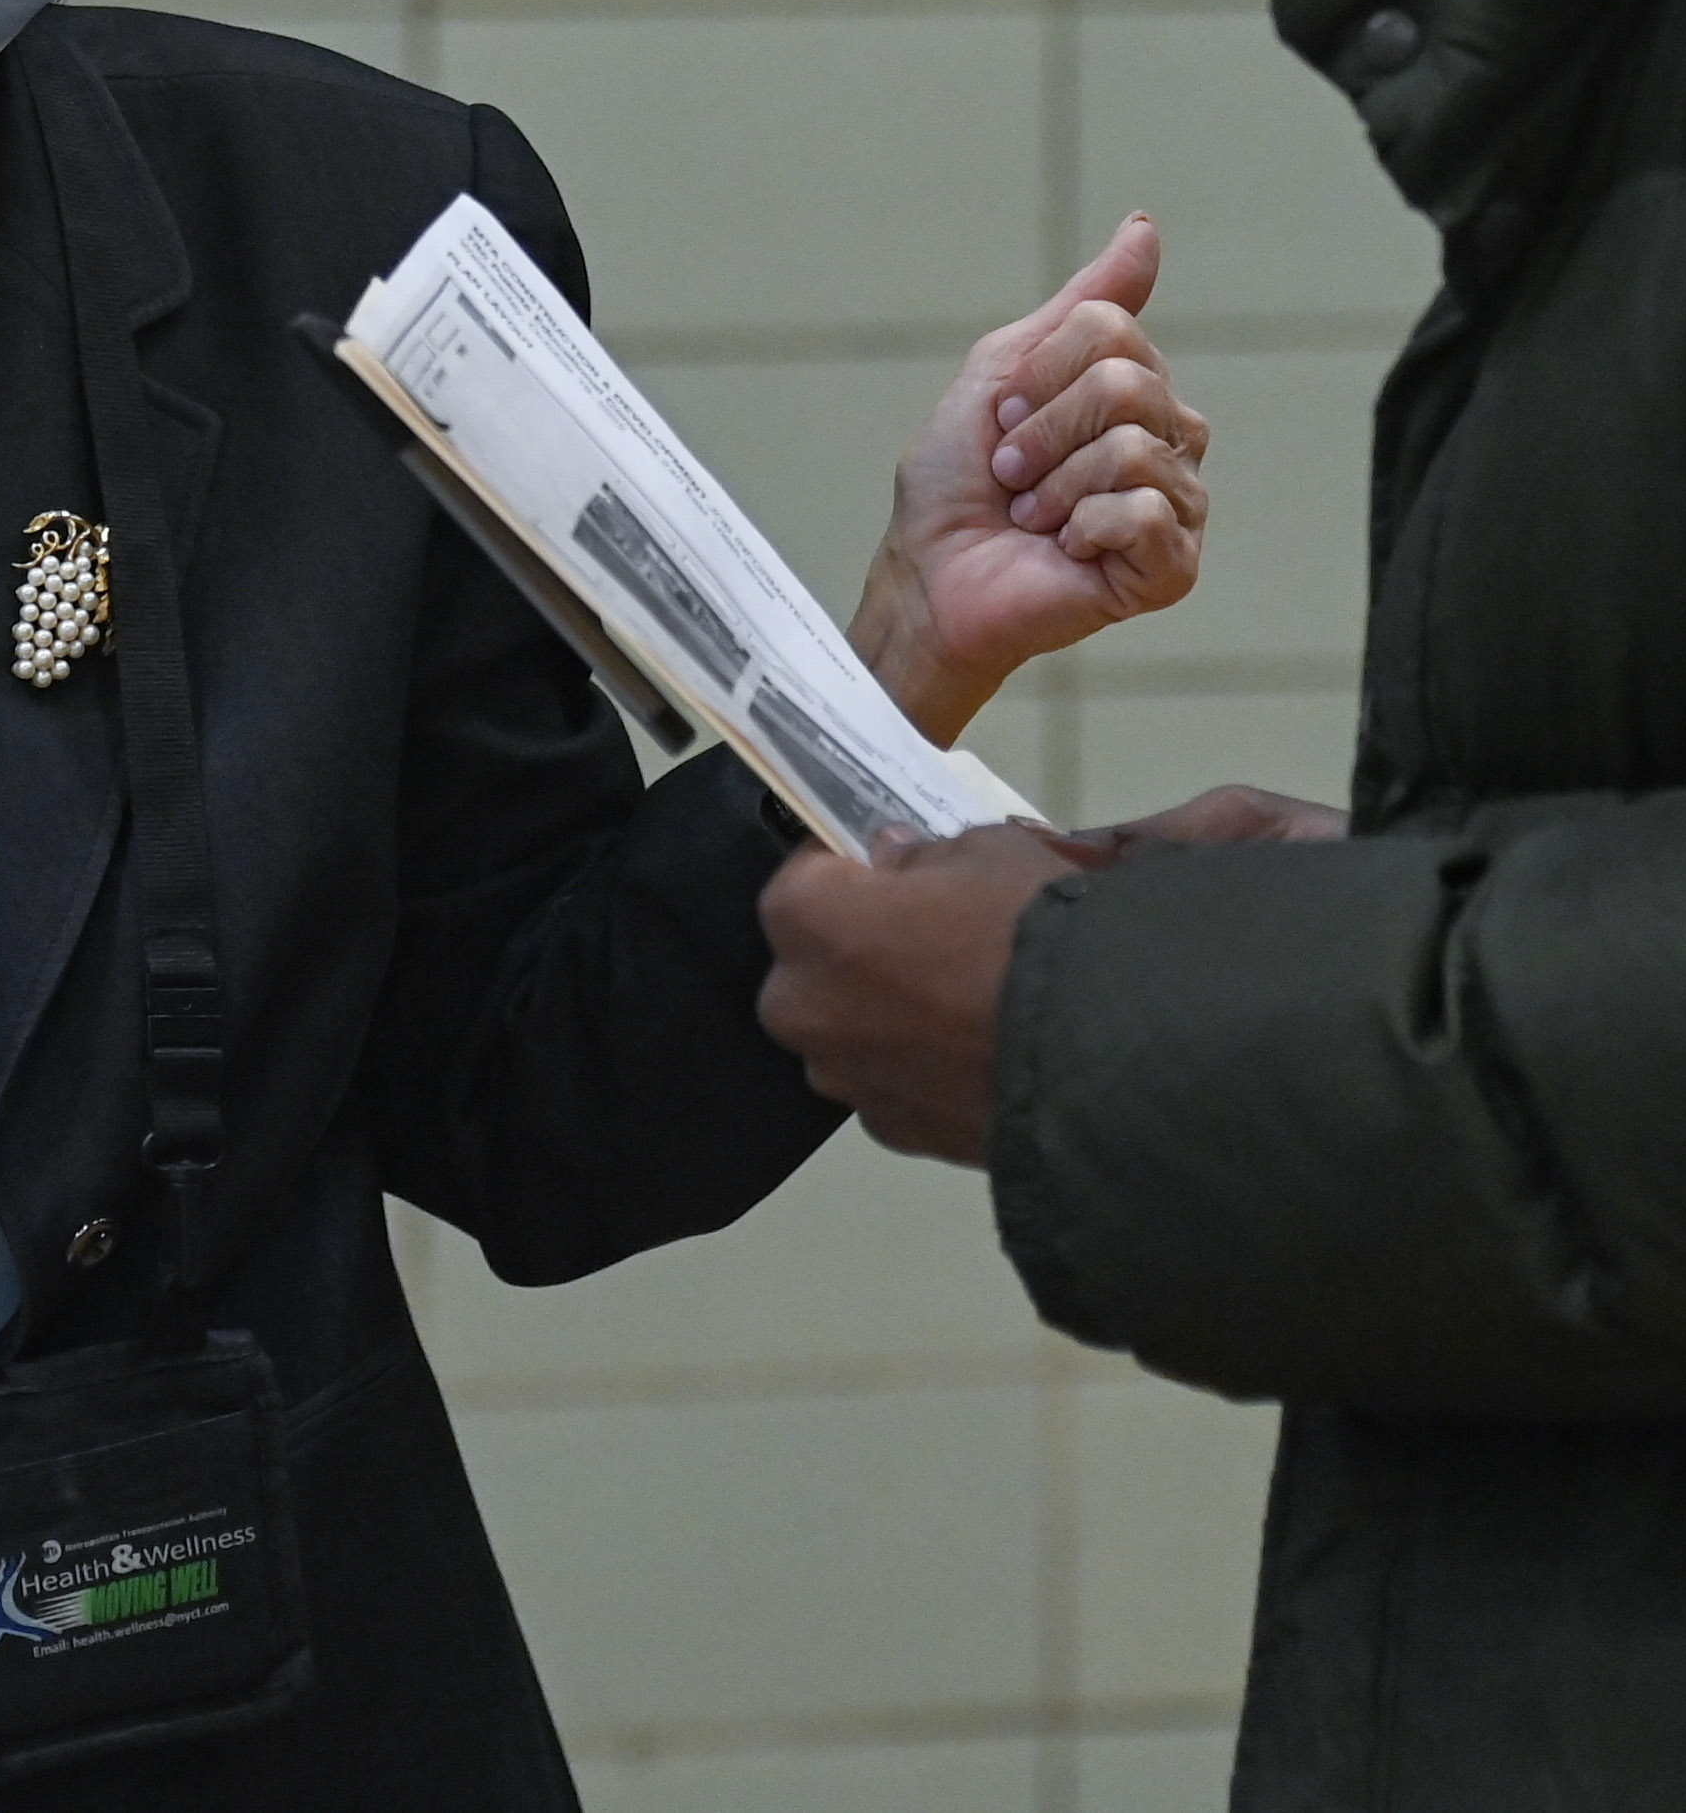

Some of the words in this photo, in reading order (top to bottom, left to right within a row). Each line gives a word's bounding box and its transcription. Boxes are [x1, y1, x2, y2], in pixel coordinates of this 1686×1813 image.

[444, 248, 483, 291] PLAN
[481, 288, 534, 351] LAYOUT
[470, 223, 501, 260] MTA
[500, 259, 600, 378] CONSTRUCTION
[612, 390, 707, 501] DEVELOPMENT
[733, 535, 817, 637] INFORMATION
[91, 1570, 167, 1624] MOVING
[170, 1558, 219, 1606] WELL
[32, 1640, 70, 1658] Email:
